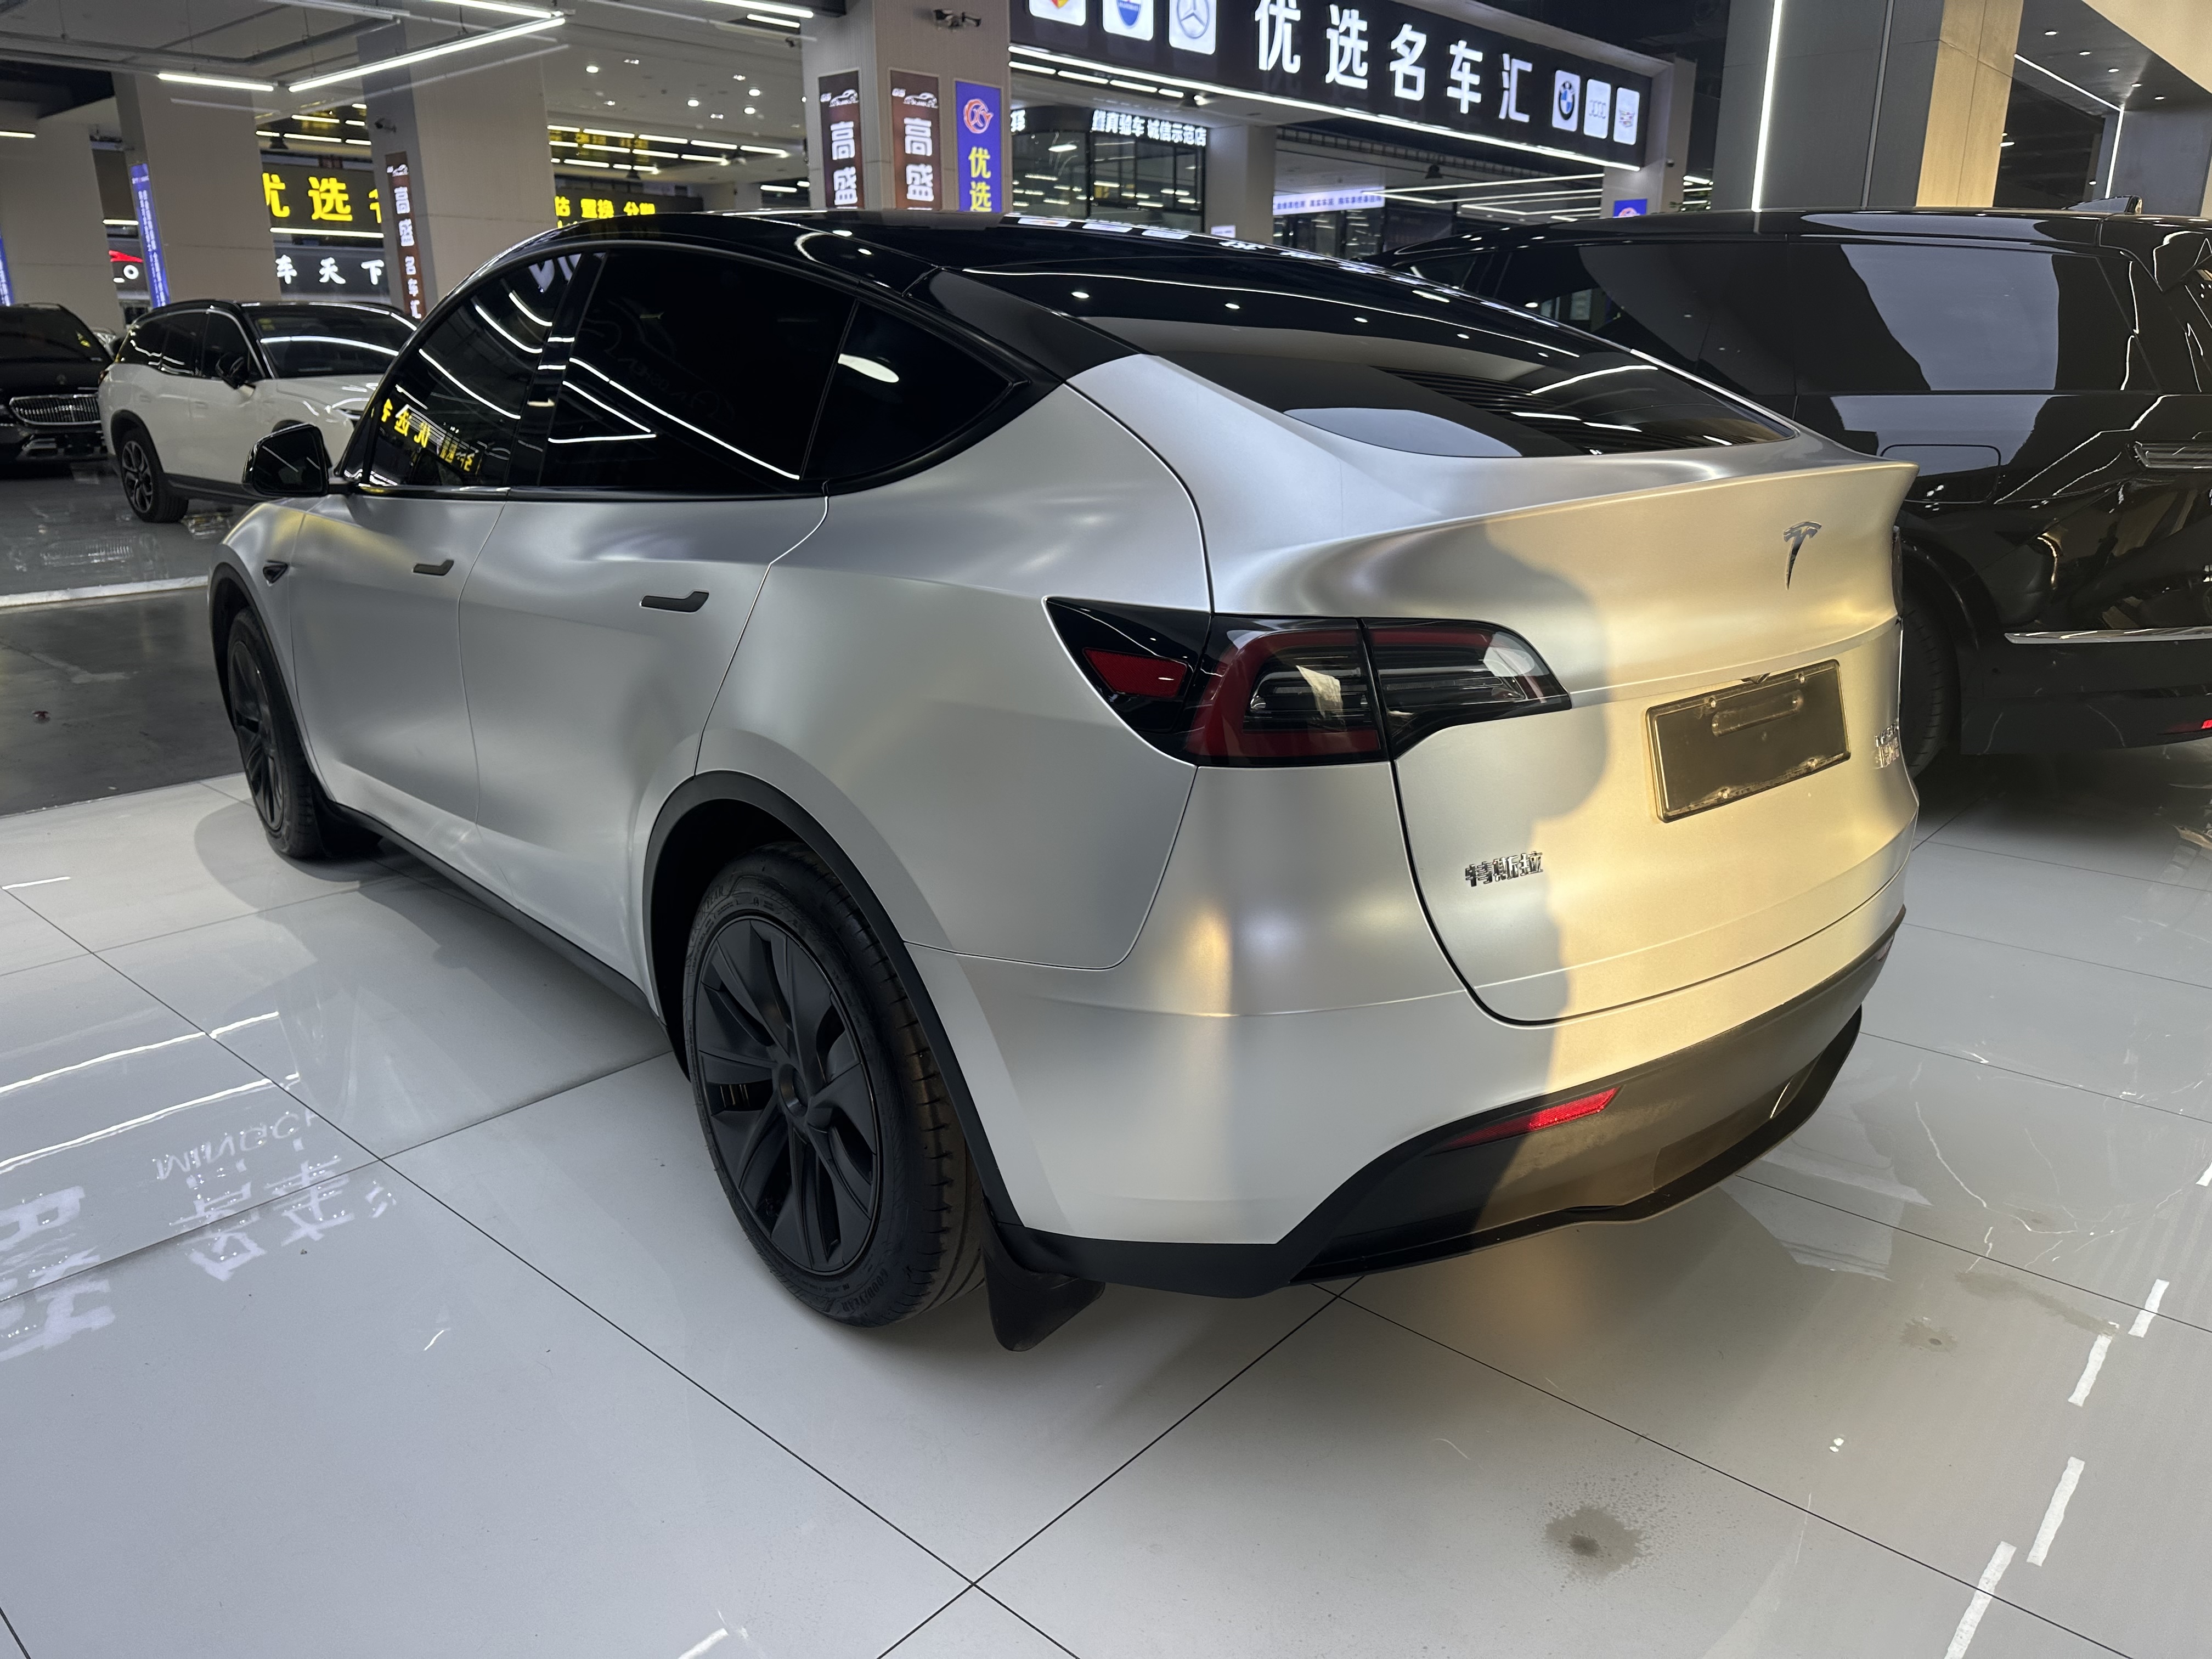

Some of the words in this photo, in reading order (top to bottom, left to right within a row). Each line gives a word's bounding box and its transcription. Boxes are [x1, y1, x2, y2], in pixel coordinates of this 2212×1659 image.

[1255, 0, 1533, 123] 优选名车汇
[830, 121, 859, 206] 高盛
[904, 117, 934, 202] 高盛
[1147, 119, 1207, 146] 诚信示范店
[968, 146, 992, 212] 优选
[1464, 850, 1544, 888] 特斯拉
[840, 1267, 889, 1312] GOODYEAR
